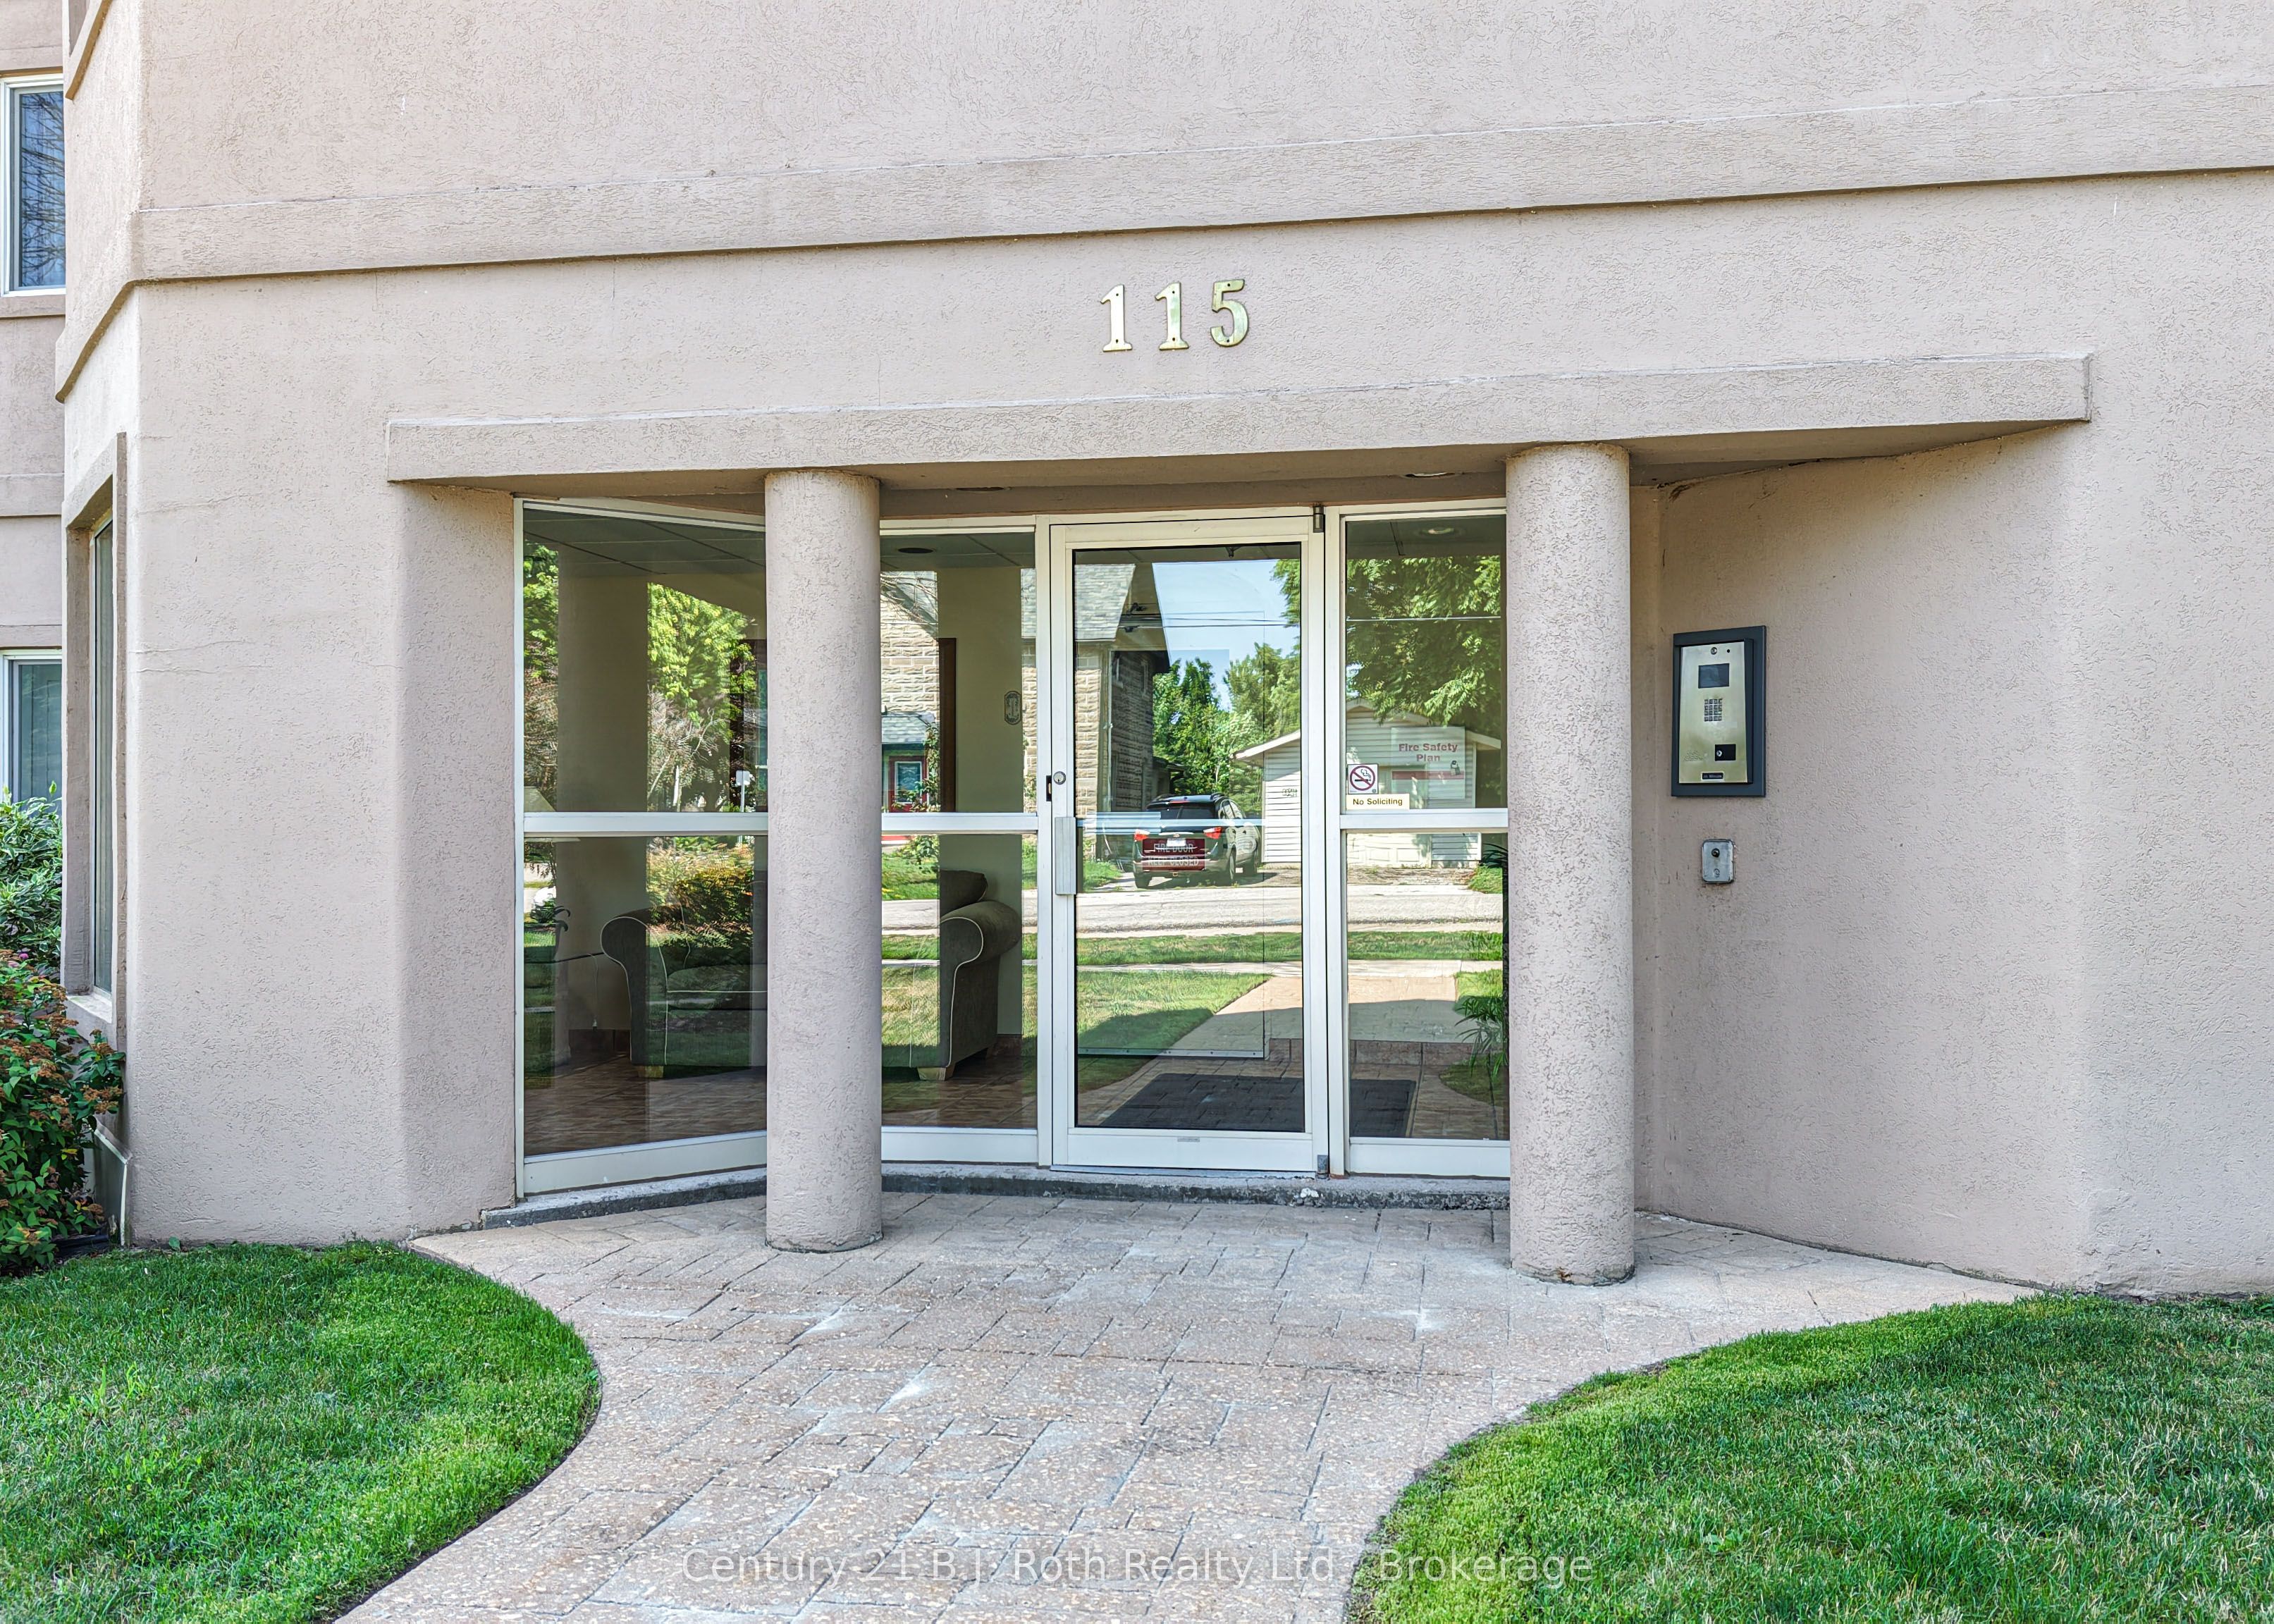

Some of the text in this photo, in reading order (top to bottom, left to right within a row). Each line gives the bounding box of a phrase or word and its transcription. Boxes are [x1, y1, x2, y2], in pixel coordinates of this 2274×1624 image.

[1100, 278, 1249, 352] 115
[1399, 743, 1458, 753] Fire Safety
[1367, 798, 1403, 806] Soliciting
